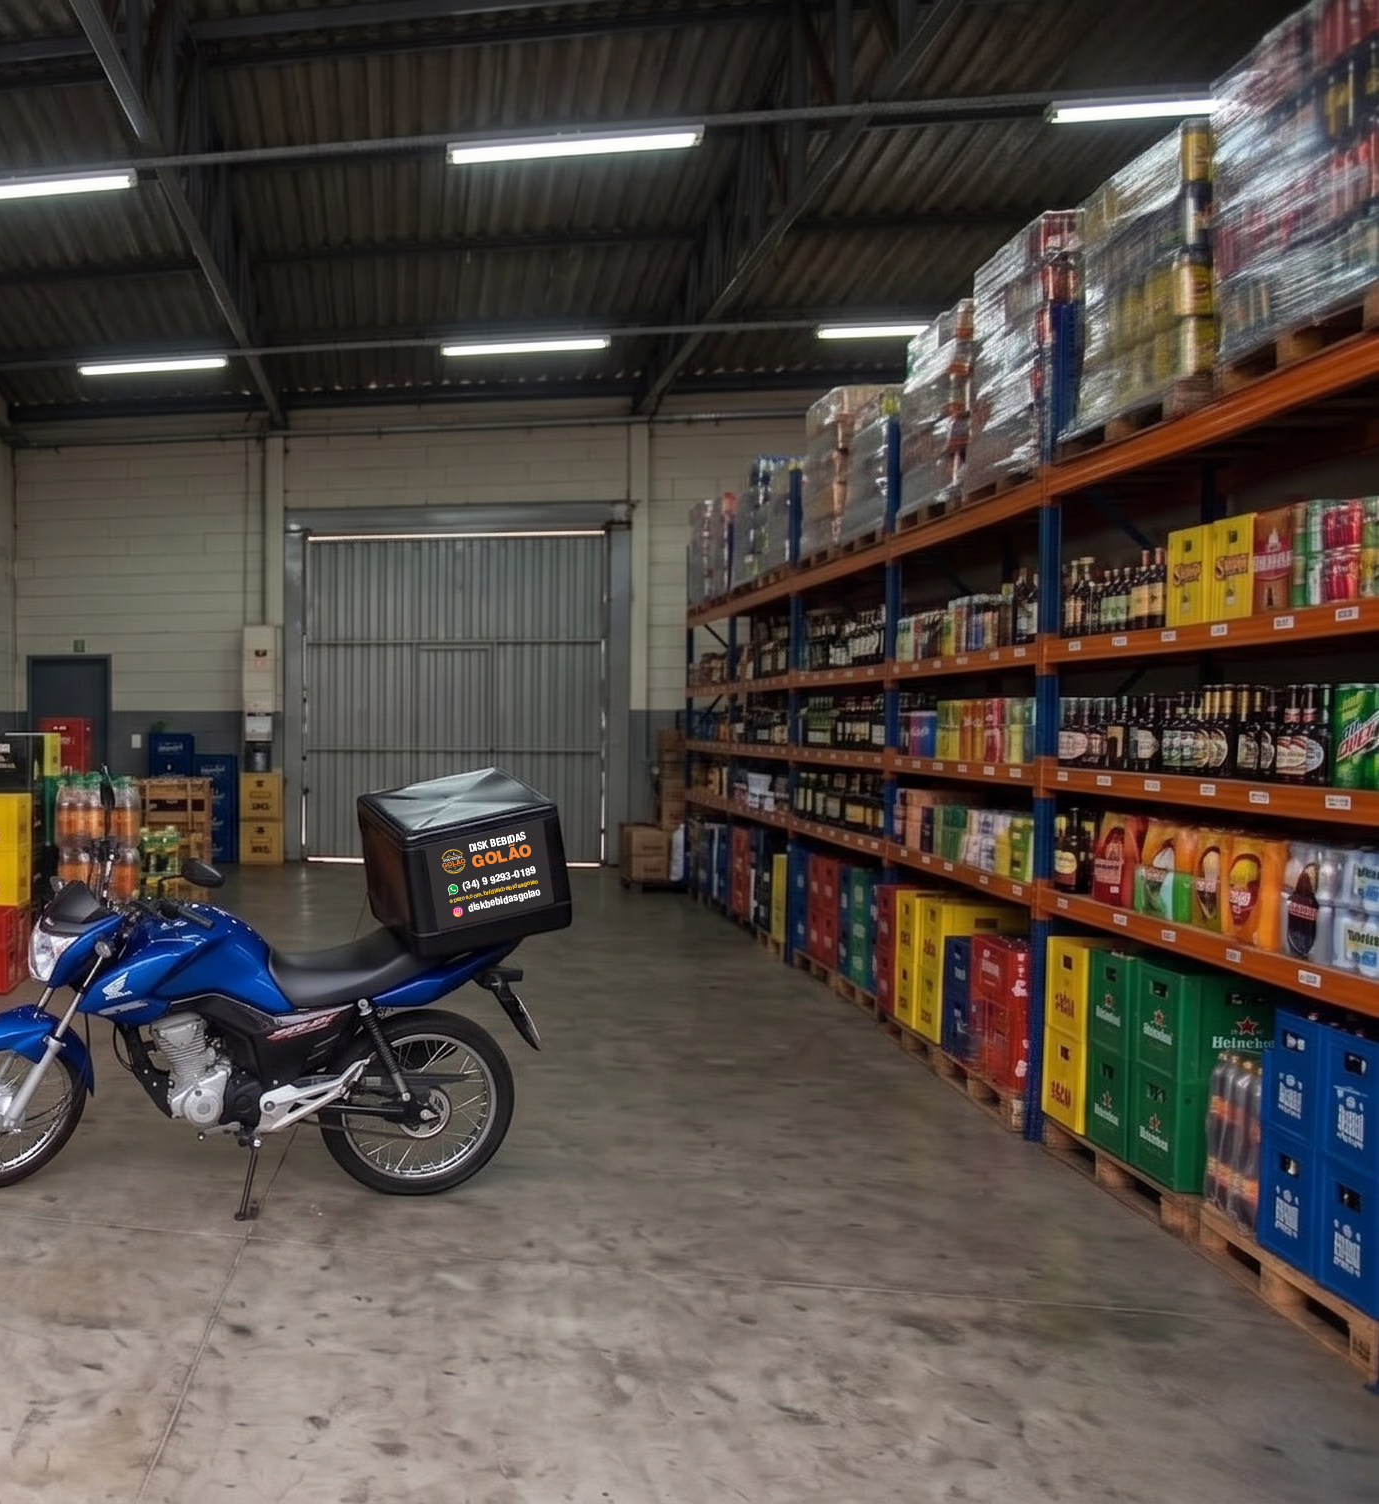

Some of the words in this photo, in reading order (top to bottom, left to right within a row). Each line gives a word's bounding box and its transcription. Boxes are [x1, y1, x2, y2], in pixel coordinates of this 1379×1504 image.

[468, 838, 489, 853] DISK
[489, 831, 527, 849] BEBIDAS
[471, 843, 532, 868] GOLÃO
[462, 878, 480, 892] (34)
[481, 876, 489, 886] 9
[490, 865, 537, 885] 9293-0189
[468, 888, 542, 913] diskbebidasgolao
